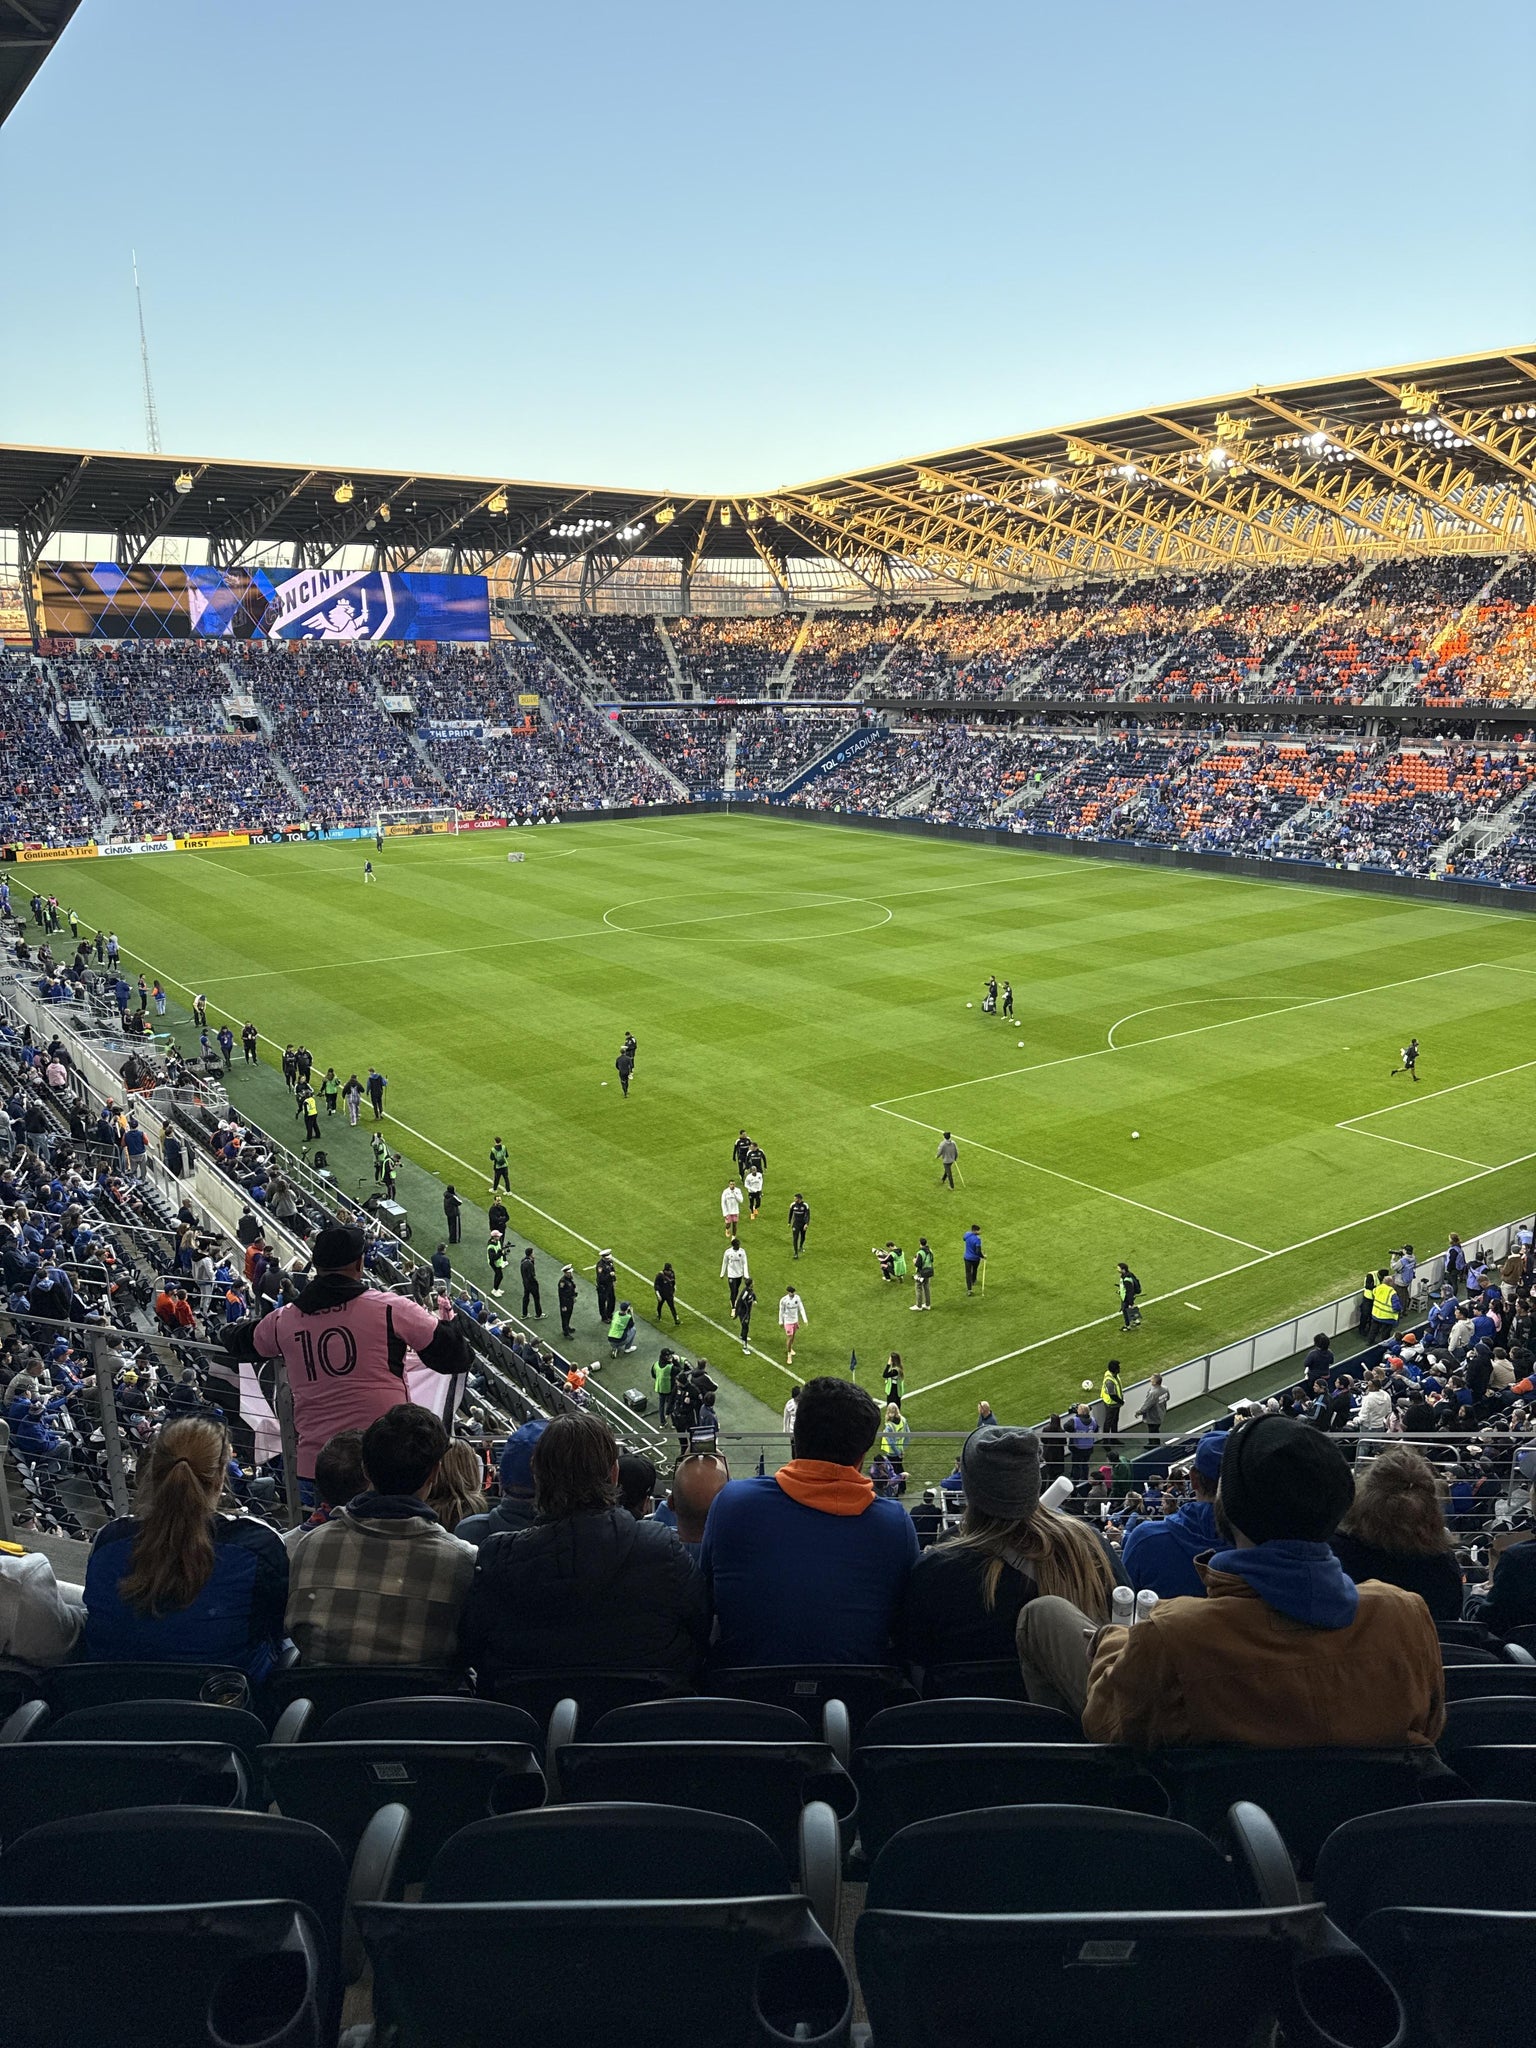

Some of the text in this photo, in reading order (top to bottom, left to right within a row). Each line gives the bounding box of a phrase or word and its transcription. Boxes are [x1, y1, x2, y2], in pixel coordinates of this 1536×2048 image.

[430, 730, 447, 738] THE
[821, 730, 880, 773] TQL STADIUM
[251, 835, 272, 844] TQL
[287, 832, 307, 841] TQL
[24, 849, 68, 860] Continental
[294, 1326, 357, 1381] 10
